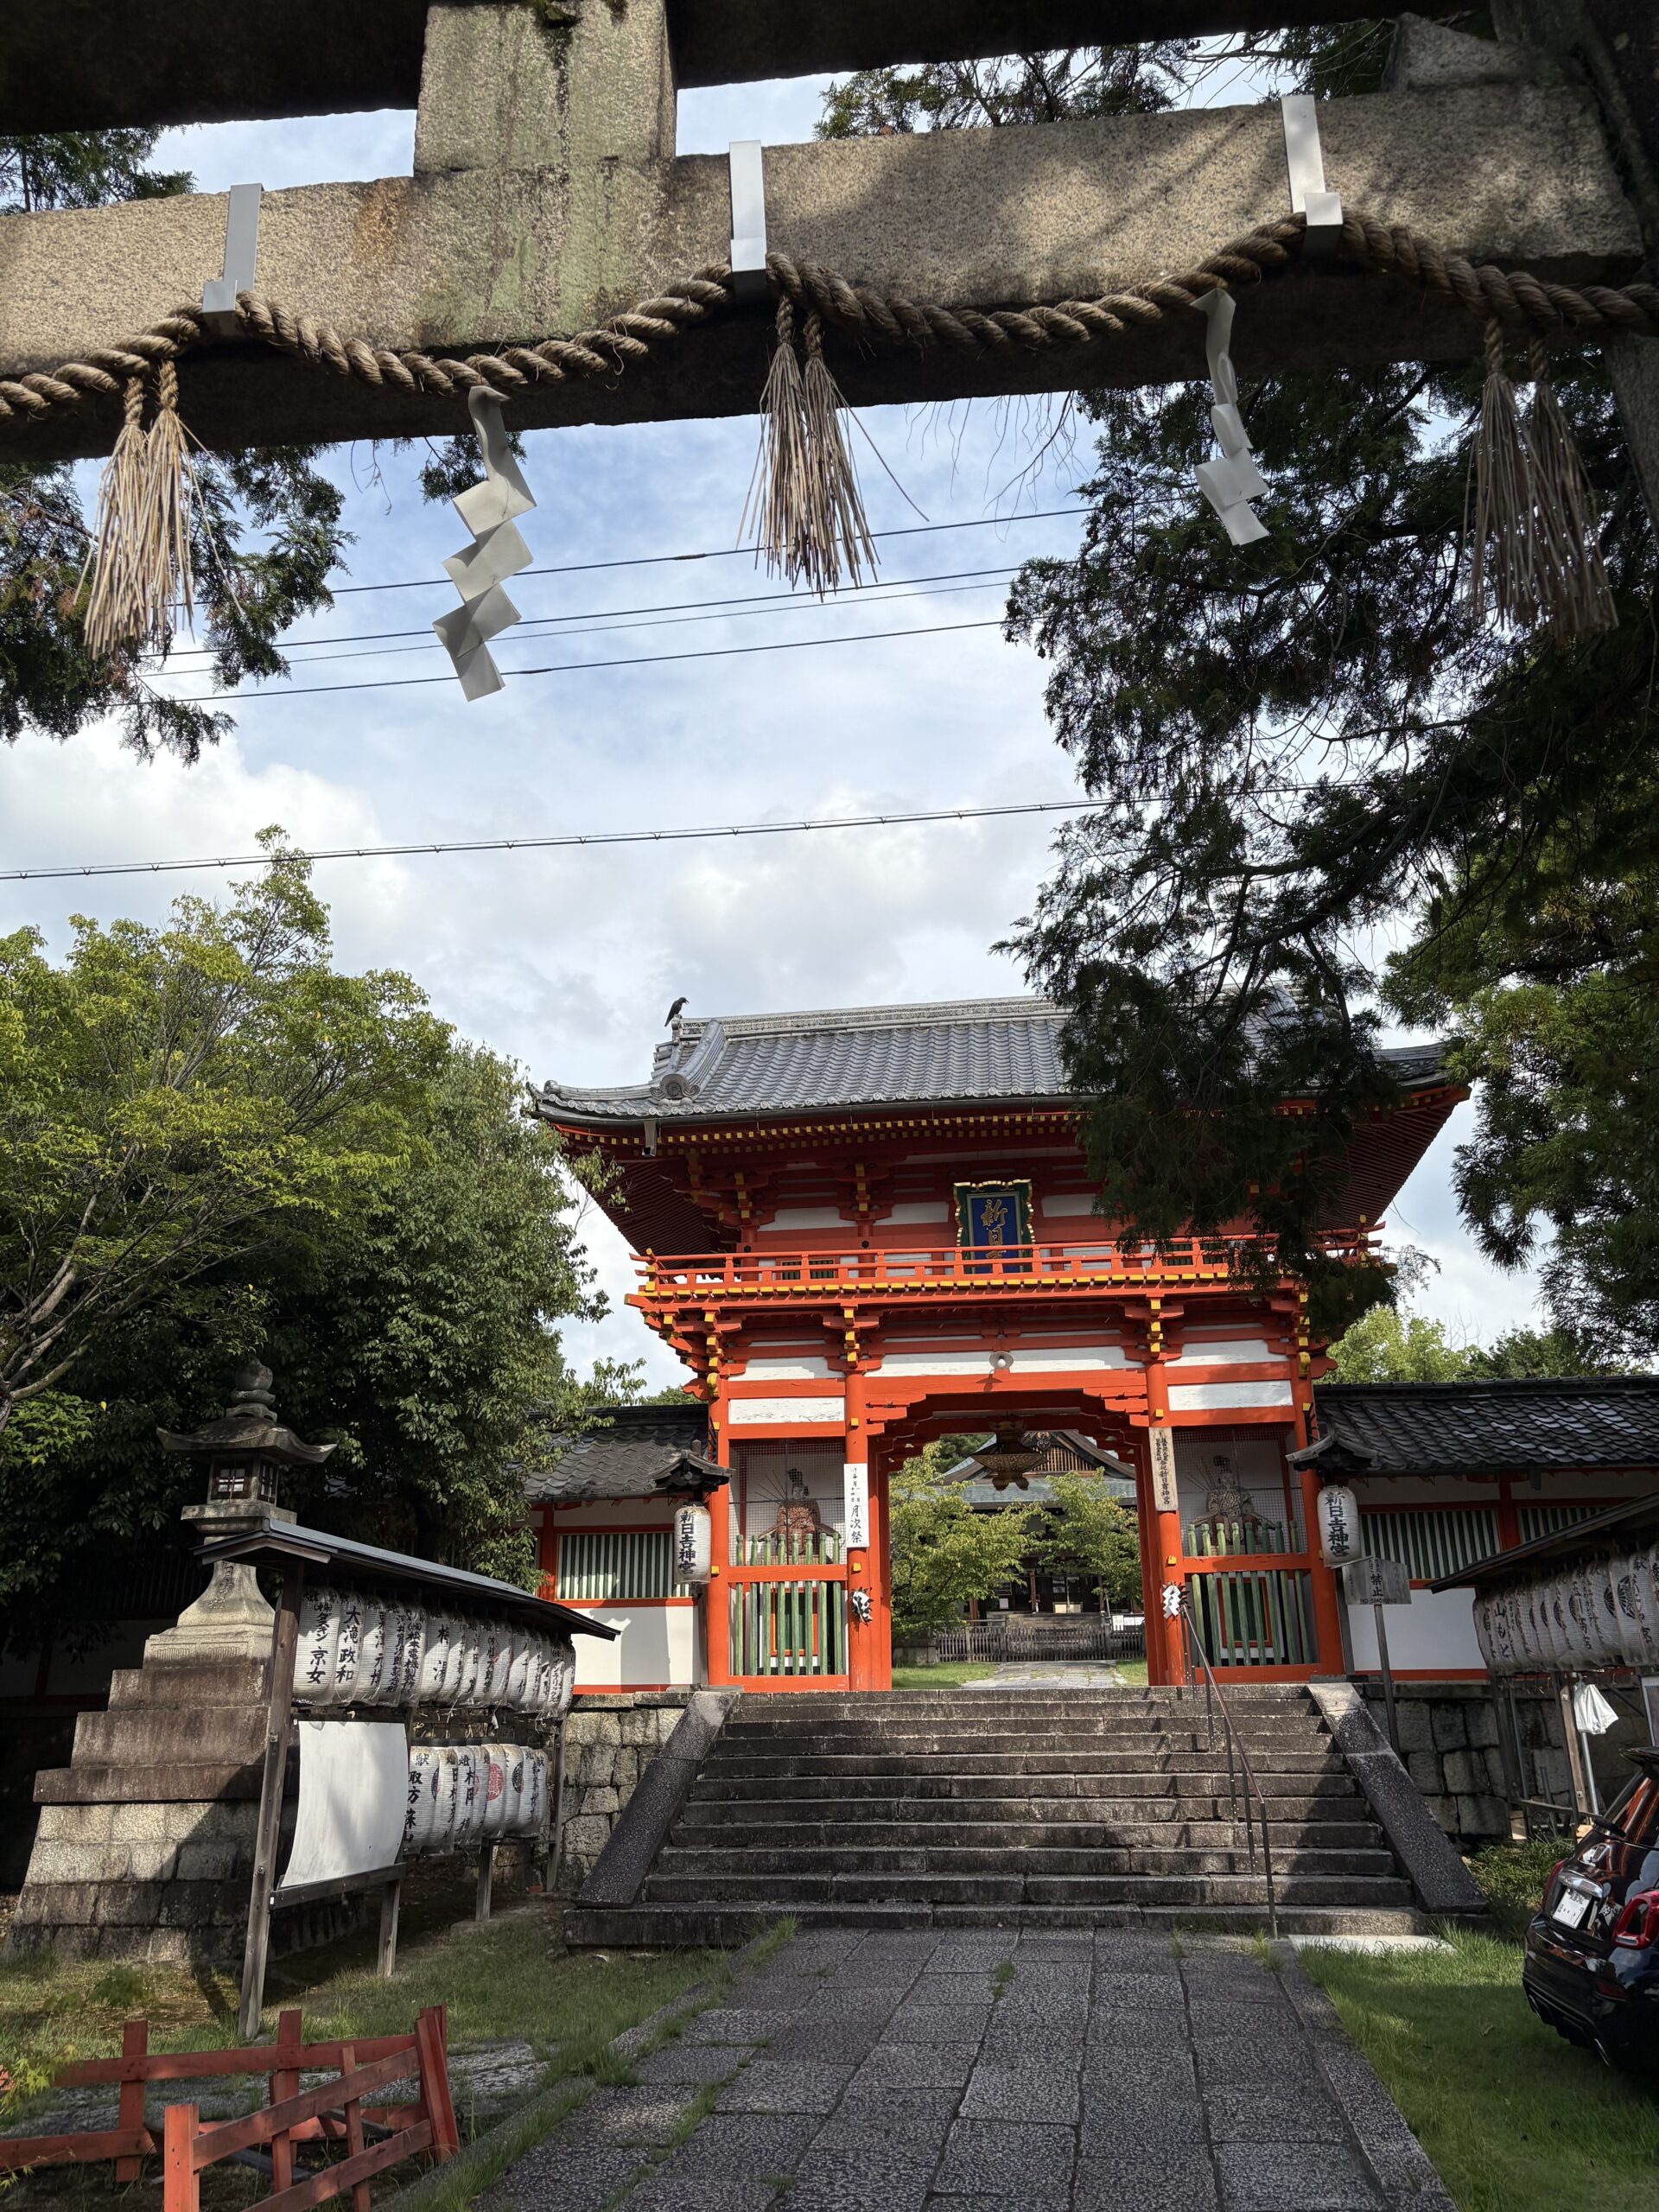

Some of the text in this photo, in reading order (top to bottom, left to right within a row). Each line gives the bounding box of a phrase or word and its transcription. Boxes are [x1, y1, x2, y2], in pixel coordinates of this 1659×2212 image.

[677, 1510, 697, 1575] 新日吉神宮
[850, 1504, 862, 1544] 月次祭
[1325, 1491, 1351, 1558] 新日吉神宮
[335, 1605, 360, 1683] 大滝政和
